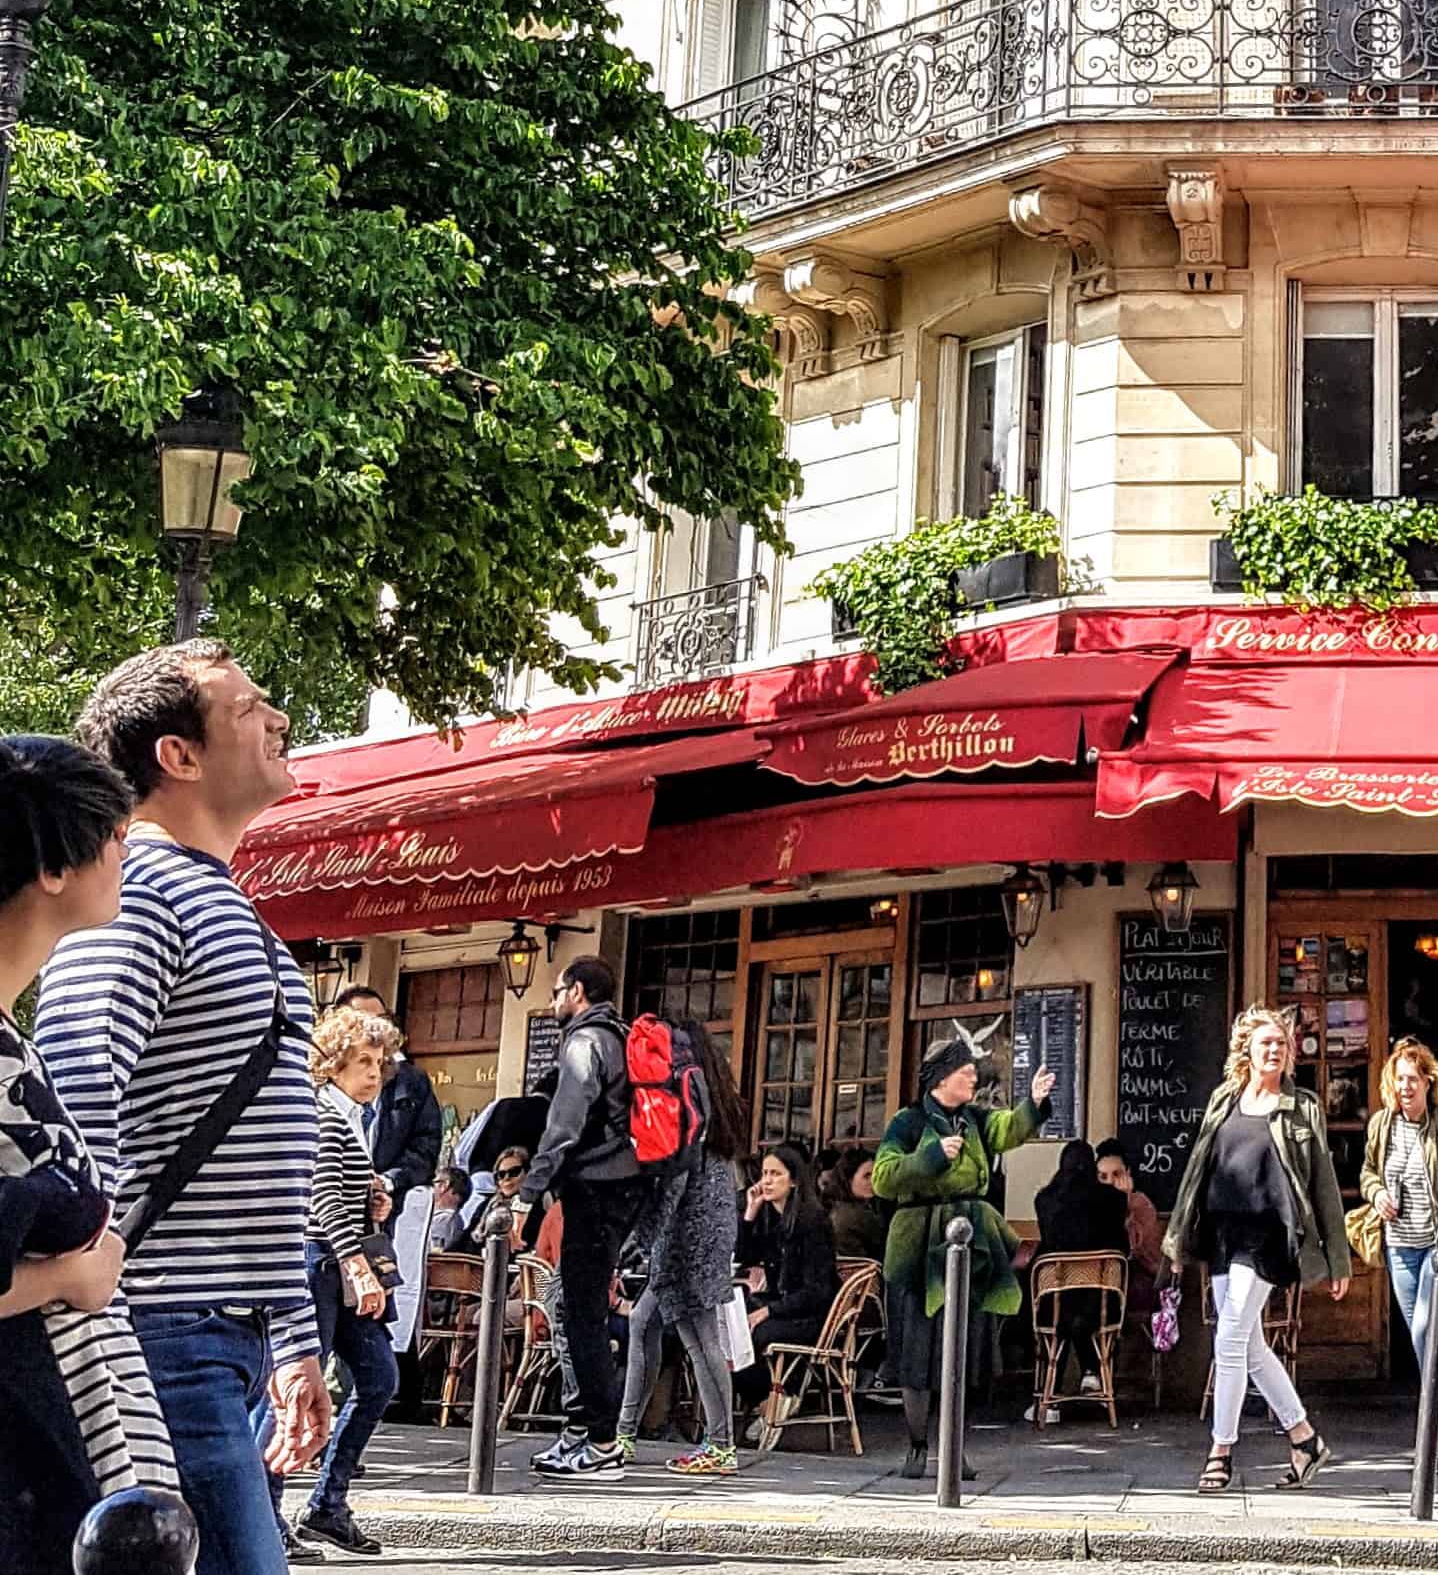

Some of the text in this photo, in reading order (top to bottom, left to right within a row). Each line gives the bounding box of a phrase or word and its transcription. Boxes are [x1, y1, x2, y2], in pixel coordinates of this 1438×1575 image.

[1207, 618, 1351, 651] Service
[836, 713, 1007, 749] Glaces & Sorbets
[887, 734, 1015, 767] Berthillon
[1232, 779, 1317, 798] l'Isle
[1253, 766, 1297, 778] La
[313, 832, 464, 879] Saint-Louis
[345, 865, 613, 919] Maison Familiale depuis 1953
[1125, 921, 1160, 949] PLAT
[1120, 1072, 1187, 1097] POMMES
